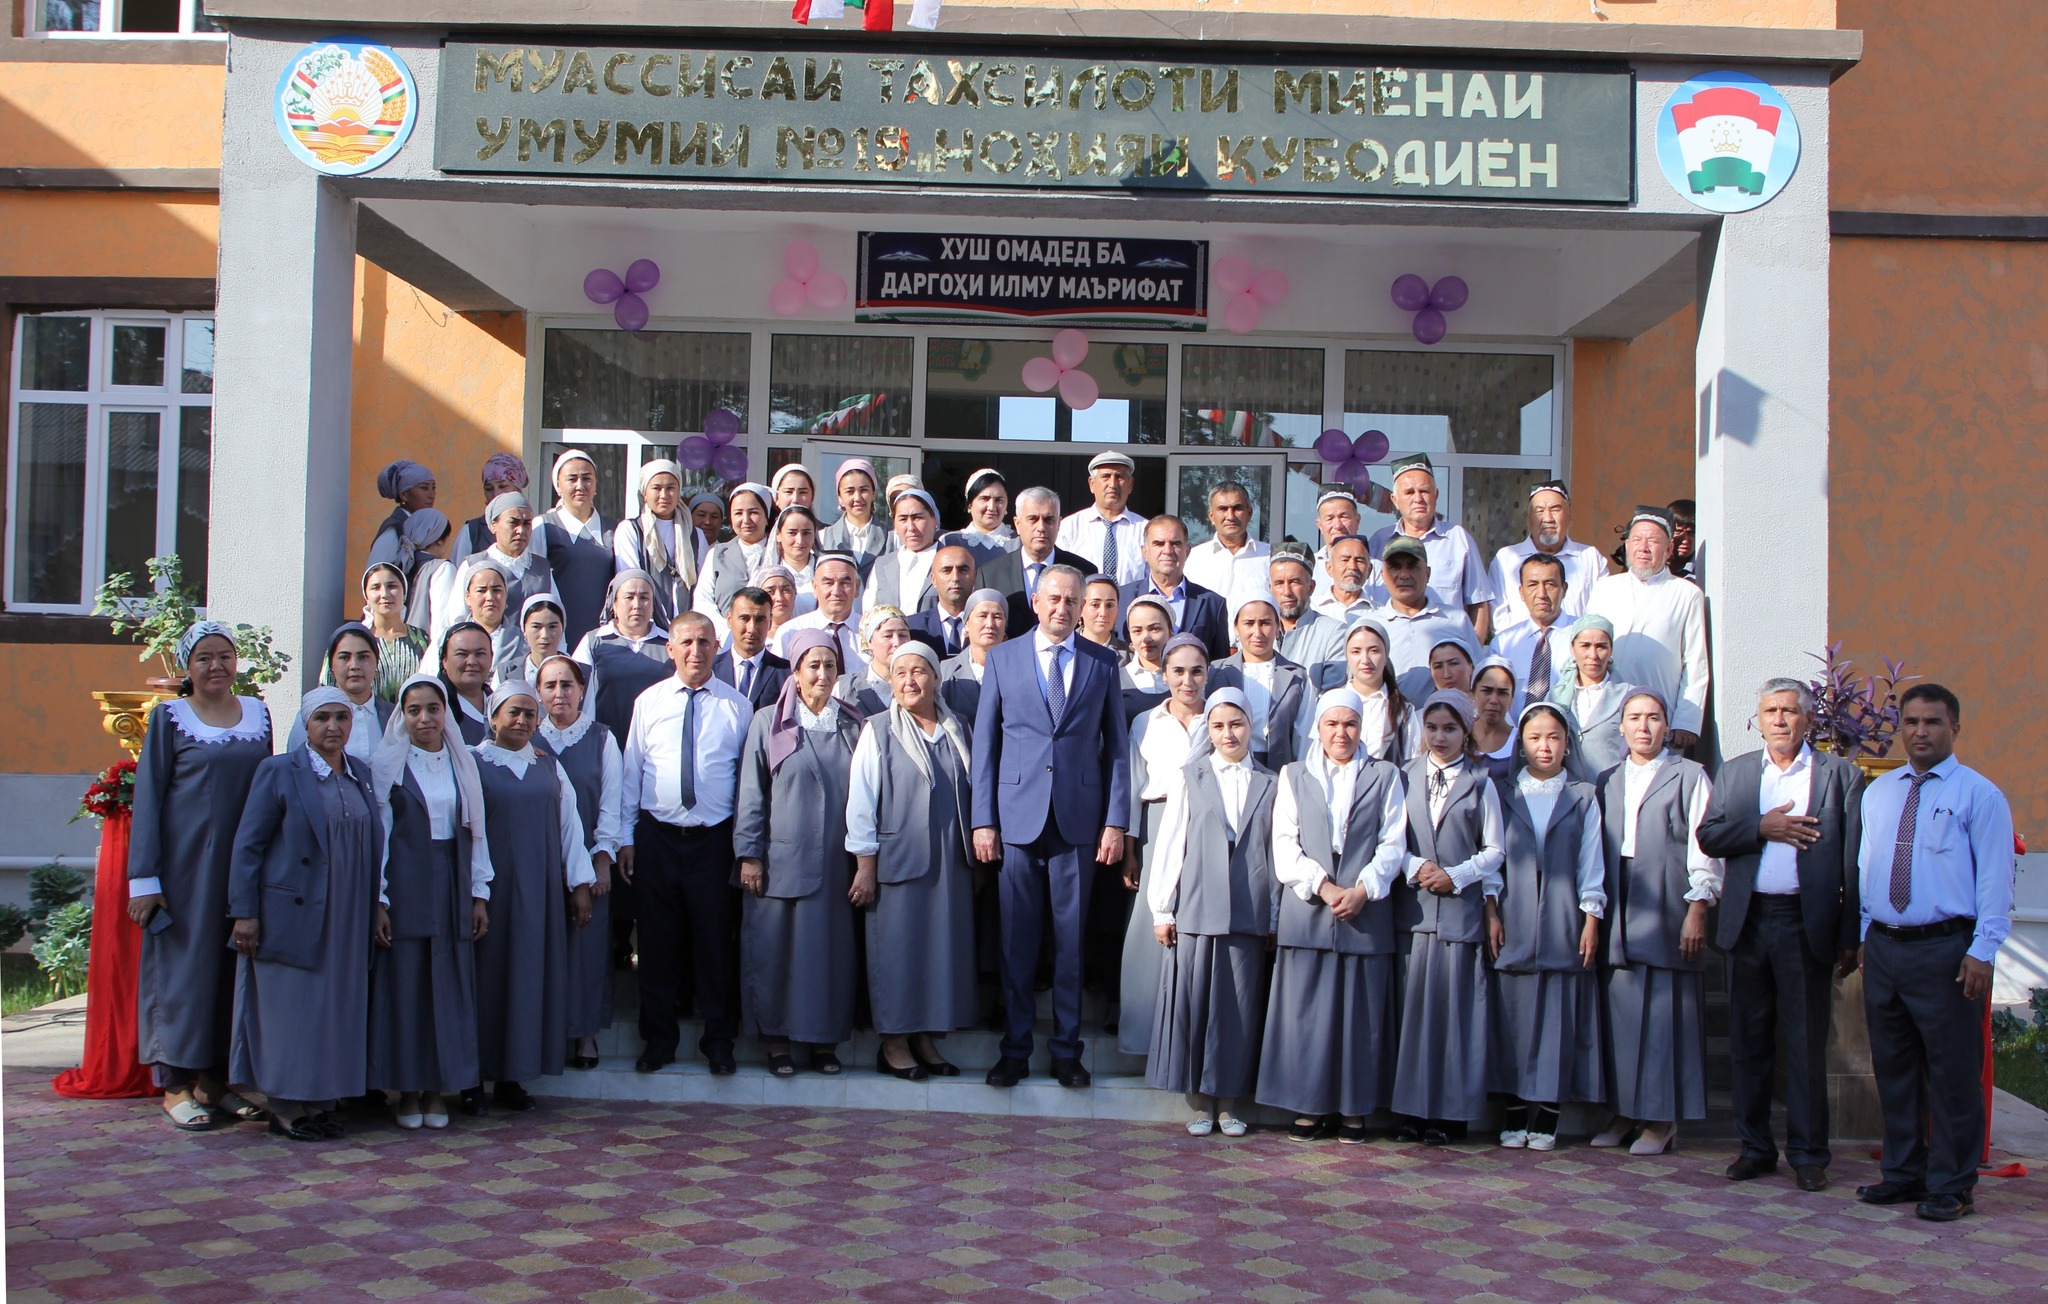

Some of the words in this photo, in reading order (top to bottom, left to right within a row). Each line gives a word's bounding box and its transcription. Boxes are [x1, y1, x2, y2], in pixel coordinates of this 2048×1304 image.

[474, 48, 843, 102] МУАССИСАИ
[475, 116, 749, 169] УМУМИИ
[940, 237, 990, 261] ХУШ
[996, 239, 1091, 267] ОМАДЕД
[1096, 242, 1126, 265] БА
[880, 272, 984, 300] ДАРГОҲИ
[990, 274, 1054, 298] ИЛМУ
[1058, 276, 1184, 301] МАЪРИФАТ
